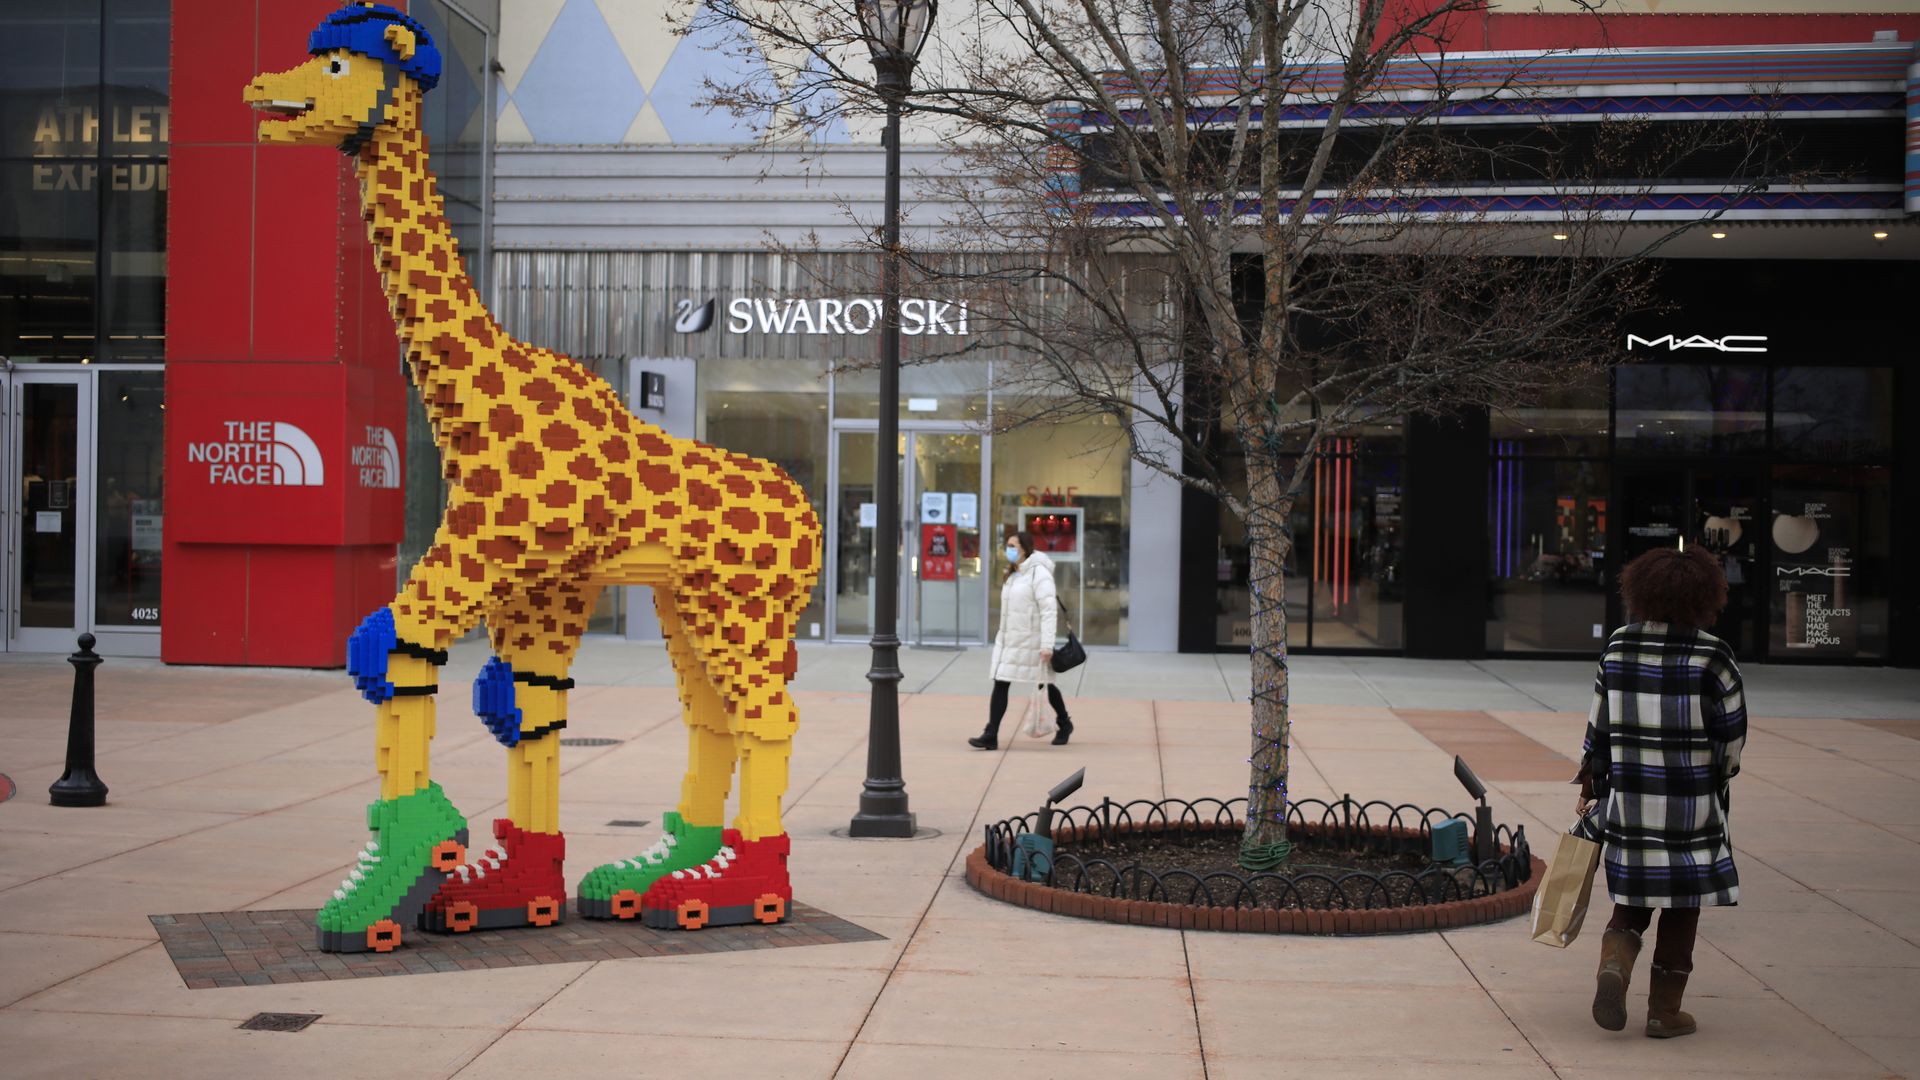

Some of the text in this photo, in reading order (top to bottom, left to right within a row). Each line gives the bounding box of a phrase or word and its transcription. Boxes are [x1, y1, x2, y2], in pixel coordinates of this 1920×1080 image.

[224, 421, 271, 441] THE
[366, 426, 384, 445] THE
[188, 443, 271, 463] NORTH
[352, 446, 384, 466] NORTH
[209, 464, 271, 484] FACE
[360, 468, 384, 487] FACE
[1024, 486, 1078, 507] SALE
[1806, 594, 1827, 602] MEET
[1806, 601, 1822, 609] THE
[131, 607, 159, 620] 4025
[1806, 609, 1851, 617] PRODUCTS
[1806, 637, 1841, 645] FAMOUS
